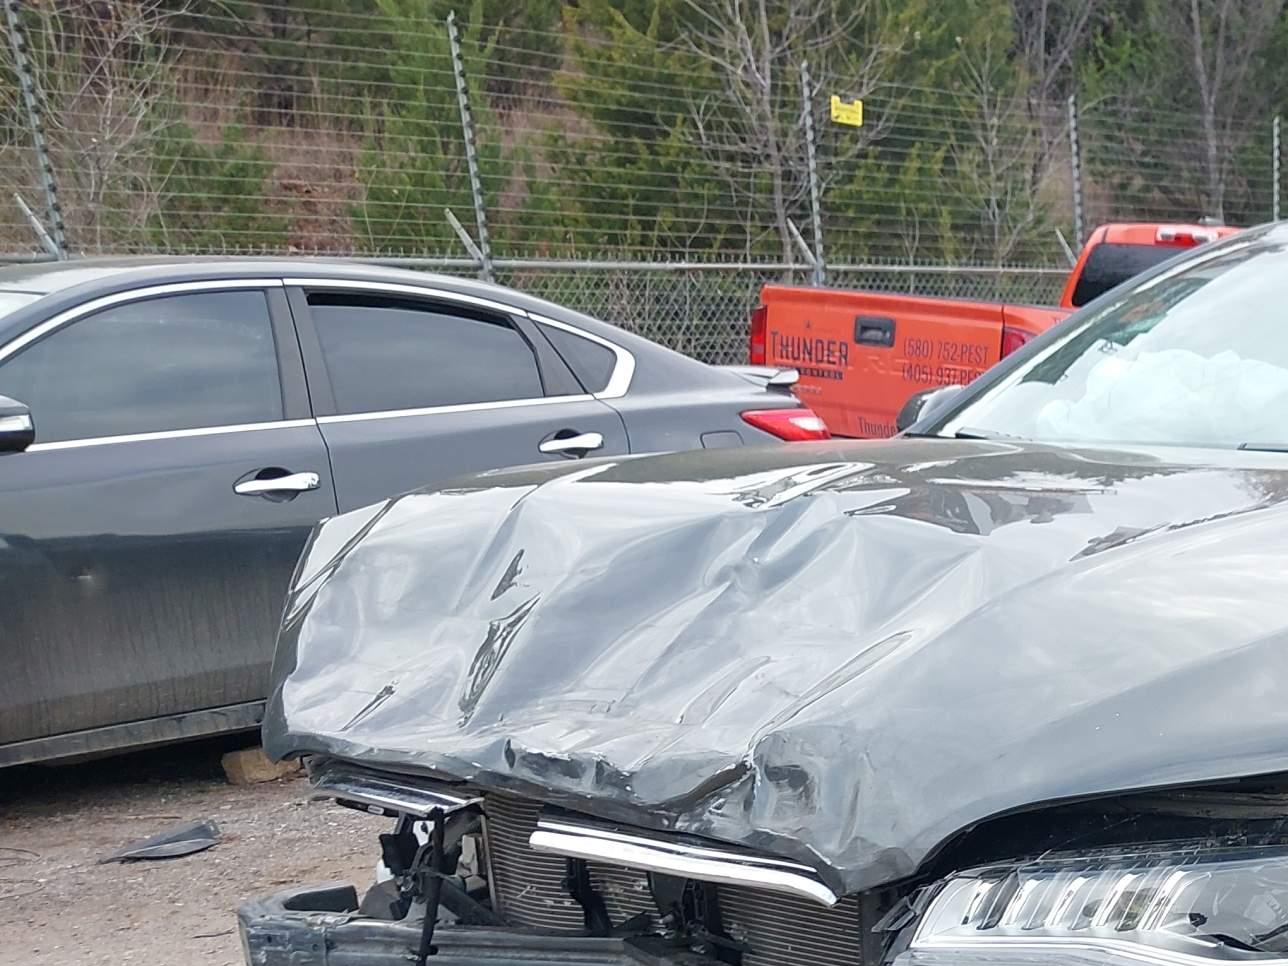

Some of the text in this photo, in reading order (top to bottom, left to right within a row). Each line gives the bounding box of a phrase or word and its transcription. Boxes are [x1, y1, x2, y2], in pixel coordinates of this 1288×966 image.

[903, 337, 934, 358] (580)
[902, 362, 986, 387] (405) 937-PE
